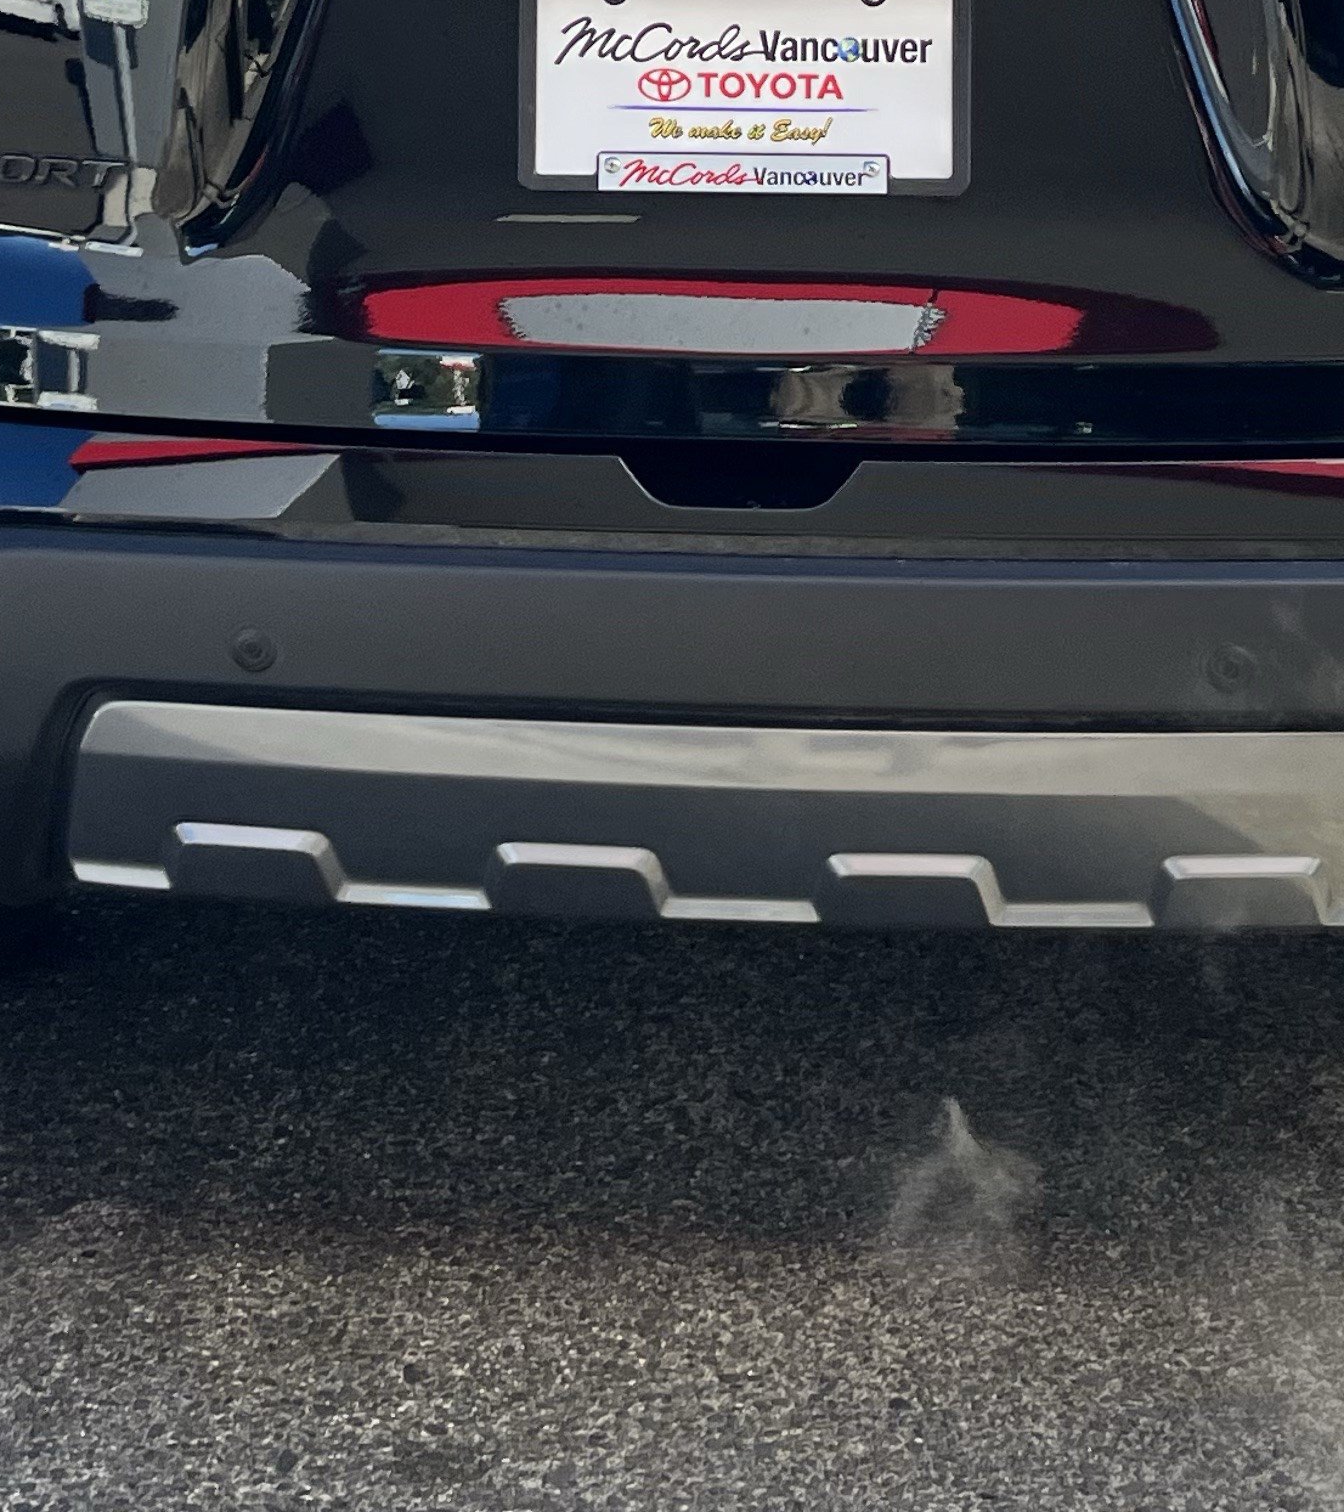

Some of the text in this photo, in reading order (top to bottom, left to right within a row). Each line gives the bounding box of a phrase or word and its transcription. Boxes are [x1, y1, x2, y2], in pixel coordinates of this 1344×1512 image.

[697, 72, 844, 100] TOYOTA
[649, 116, 833, 146] We make it Easy!
